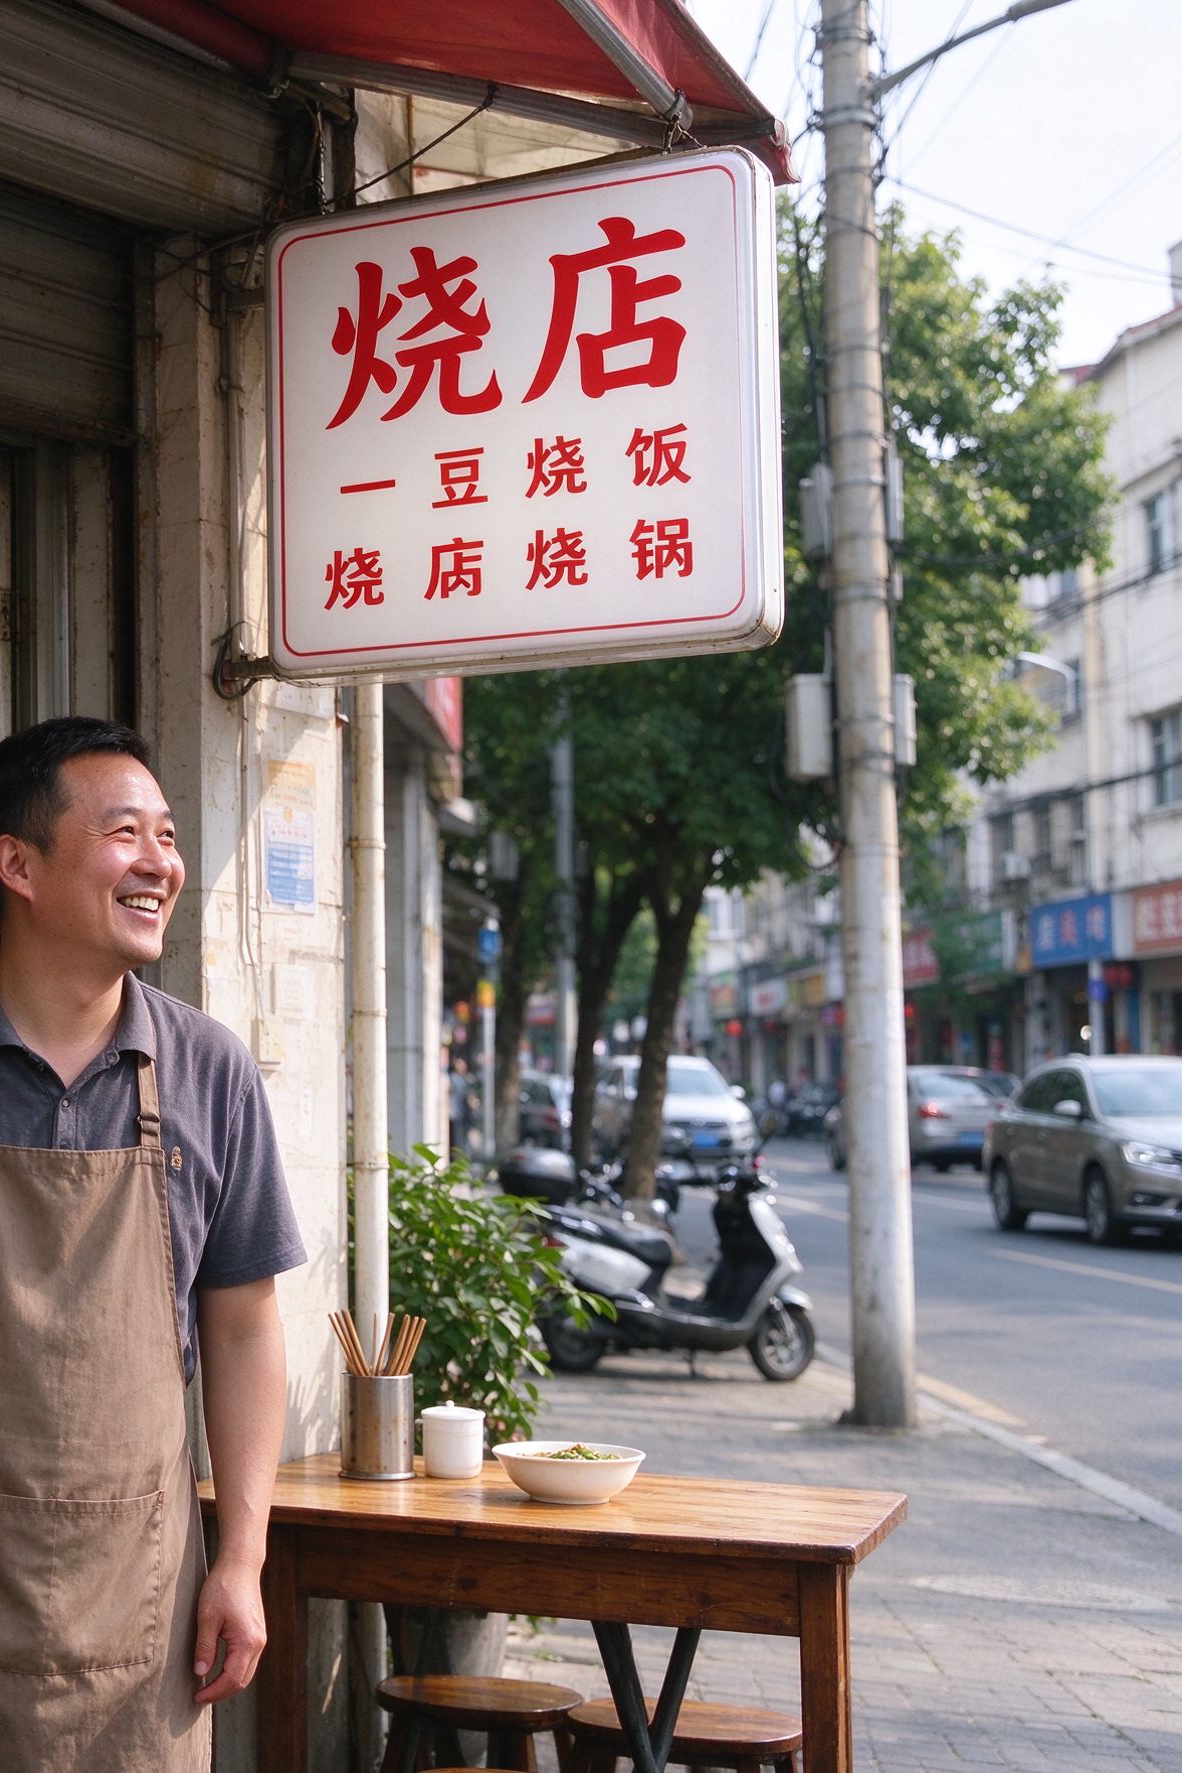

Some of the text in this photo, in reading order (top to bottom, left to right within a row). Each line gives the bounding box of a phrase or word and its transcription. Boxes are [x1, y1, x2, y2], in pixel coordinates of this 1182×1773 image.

[325, 215, 689, 430] 烧店
[339, 422, 693, 510] 一豆烧饭
